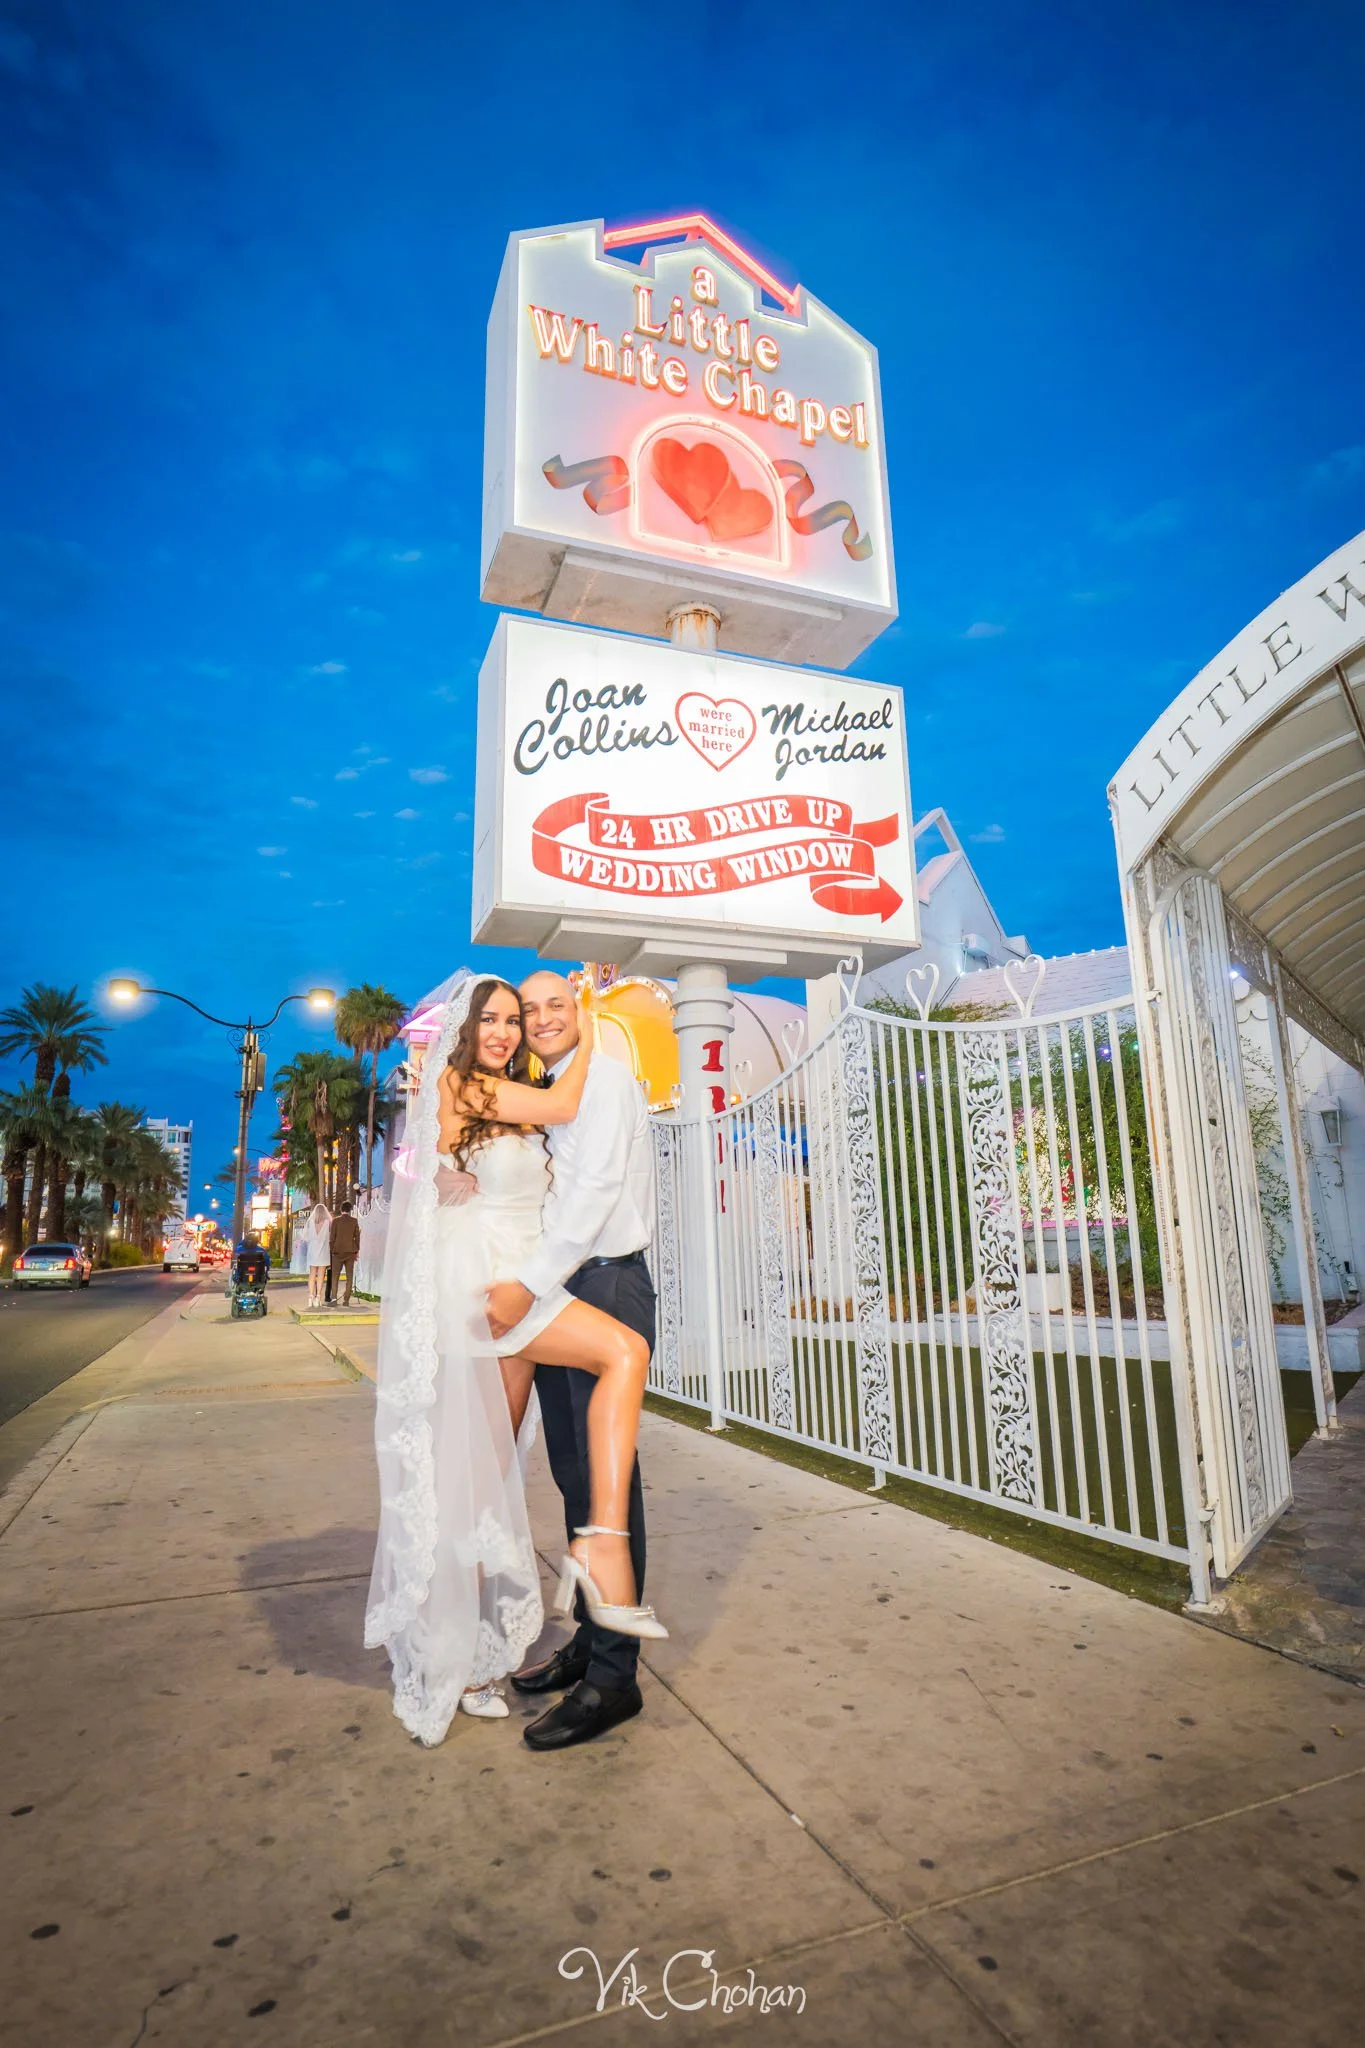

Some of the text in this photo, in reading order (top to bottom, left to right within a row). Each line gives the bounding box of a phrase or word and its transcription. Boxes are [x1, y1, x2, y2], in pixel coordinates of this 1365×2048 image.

[691, 266, 718, 306] a
[633, 284, 780, 373] Little
[528, 304, 871, 450] White Chapel
[545, 677, 647, 733] Joan
[688, 721, 745, 739] married
[700, 708, 732, 722] were
[761, 698, 893, 734] Michael
[1129, 621, 1303, 814] LITTLE
[513, 713, 680, 775] Collins
[702, 735, 732, 752] here
[775, 733, 887, 781] Jordan
[600, 798, 843, 848] 24 HR DRIVE UP
[559, 841, 855, 892] WEDDING WINDOW
